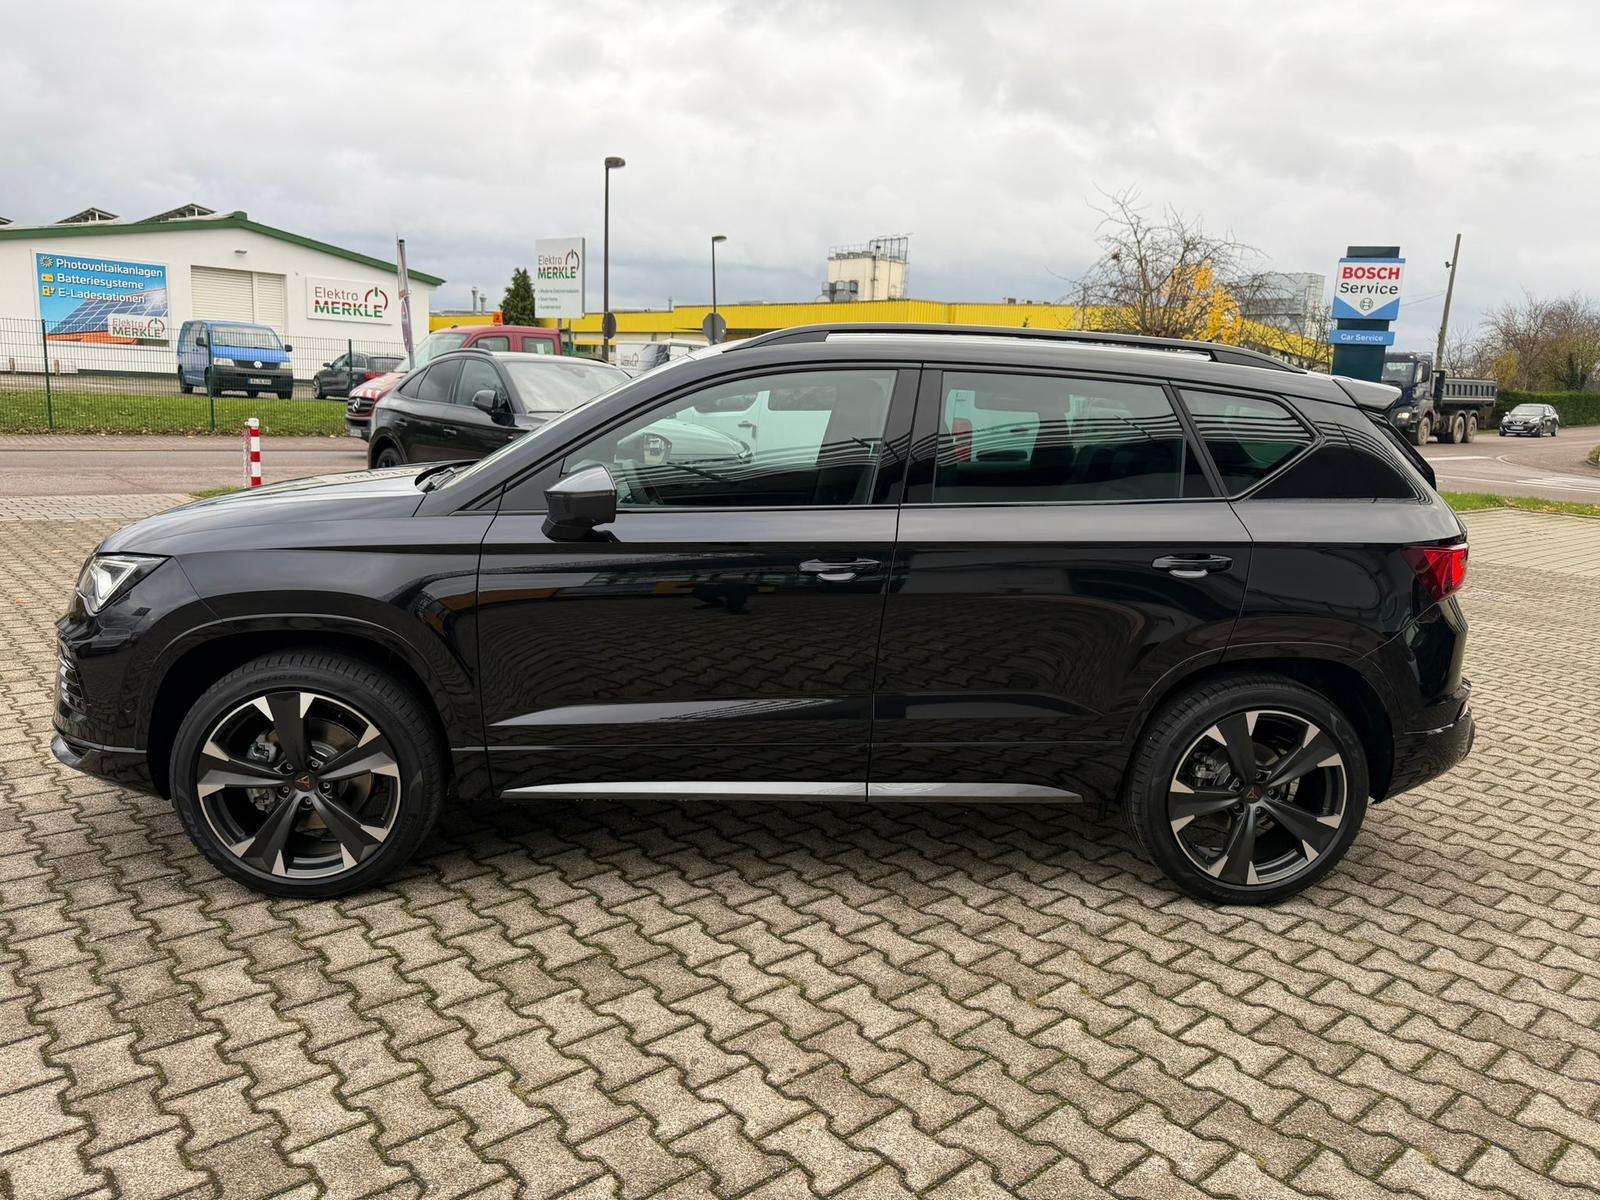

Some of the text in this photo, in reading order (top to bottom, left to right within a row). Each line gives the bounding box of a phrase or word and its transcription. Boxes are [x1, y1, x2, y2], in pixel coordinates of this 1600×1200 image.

[538, 255, 563, 265] Elektro
[56, 258, 163, 278] Photovoltaikanlagen
[537, 266, 577, 279] MERKLE
[1342, 266, 1400, 280] BOSCH
[57, 273, 144, 289] Batteriesysteme
[58, 287, 145, 303] E-Ladestationen
[314, 286, 359, 301] Elektro
[1339, 282, 1399, 295] Service
[314, 299, 383, 318] MERKLE
[112, 317, 144, 328] Elektro
[112, 326, 161, 338] MERKLE
[1340, 333, 1384, 341] Car Service
